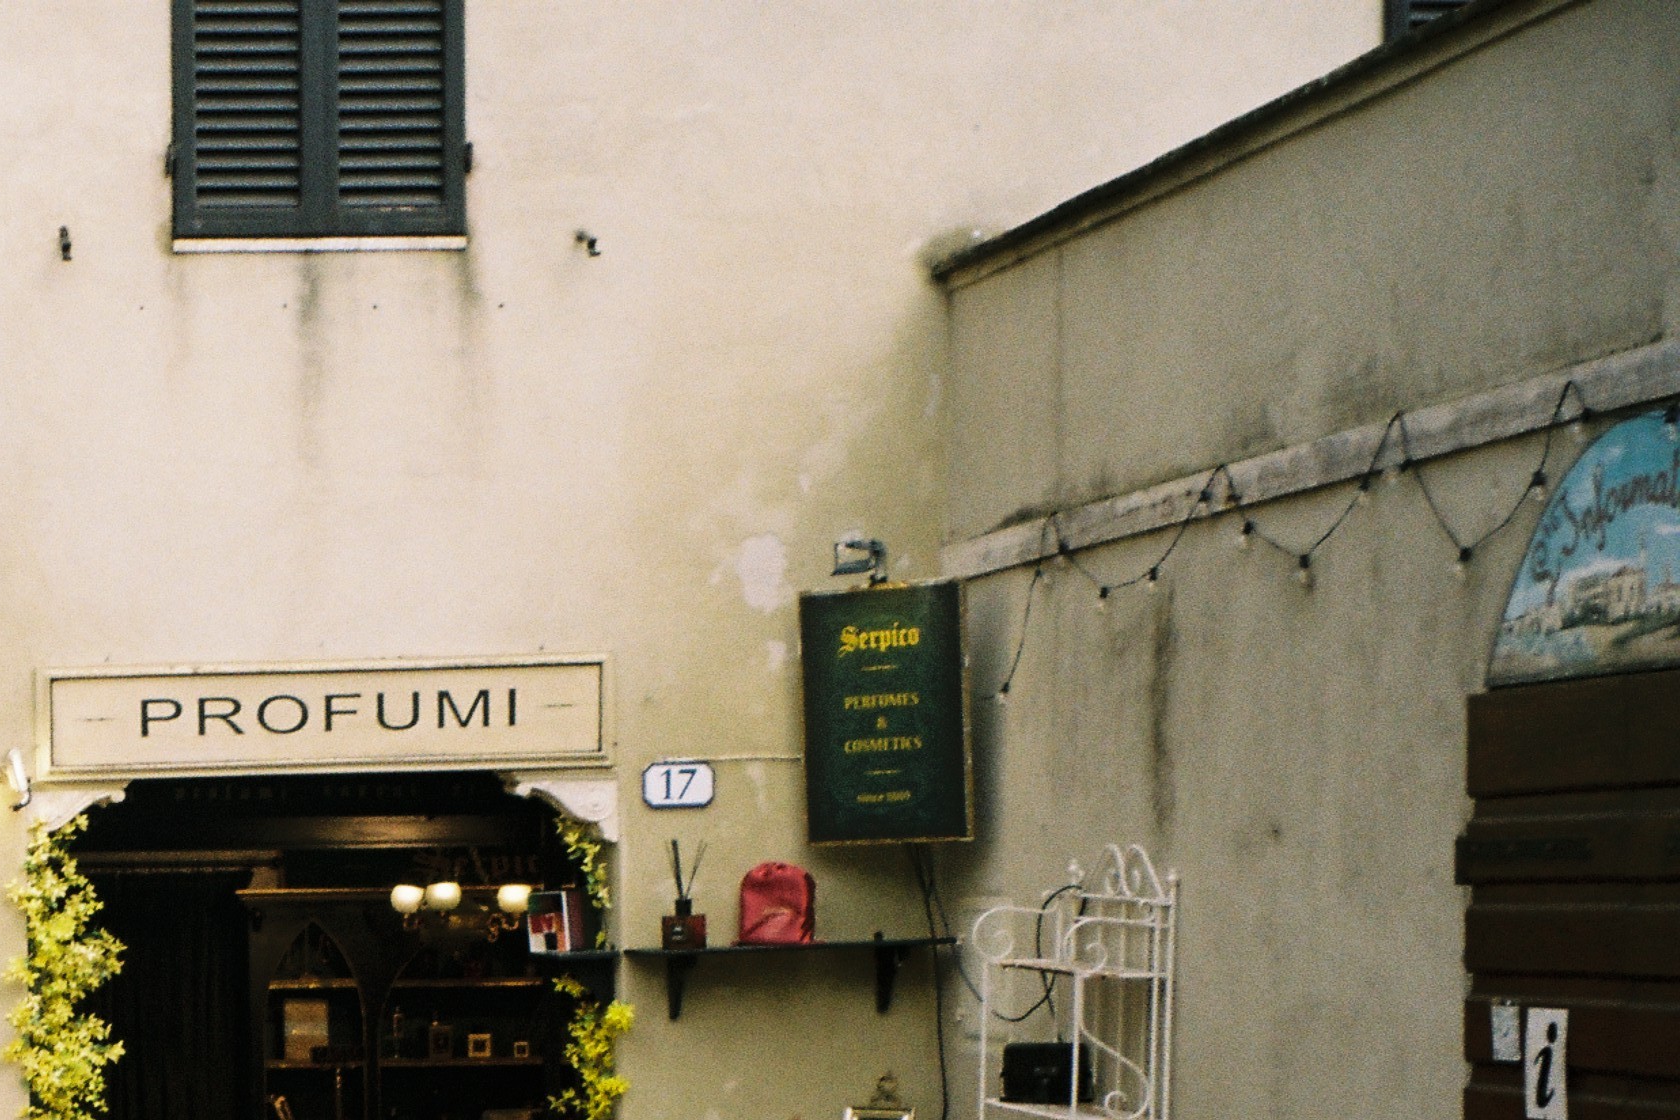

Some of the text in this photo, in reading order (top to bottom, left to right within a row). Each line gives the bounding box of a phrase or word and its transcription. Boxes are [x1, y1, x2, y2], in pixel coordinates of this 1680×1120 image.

[837, 621, 921, 657] Serpico
[139, 688, 518, 738] PROFUMI
[844, 691, 920, 710] PERFUMES
[876, 716, 888, 730] &
[844, 735, 922, 754] COSMETICS
[660, 768, 697, 800] 17
[1535, 1022, 1557, 1108] i
